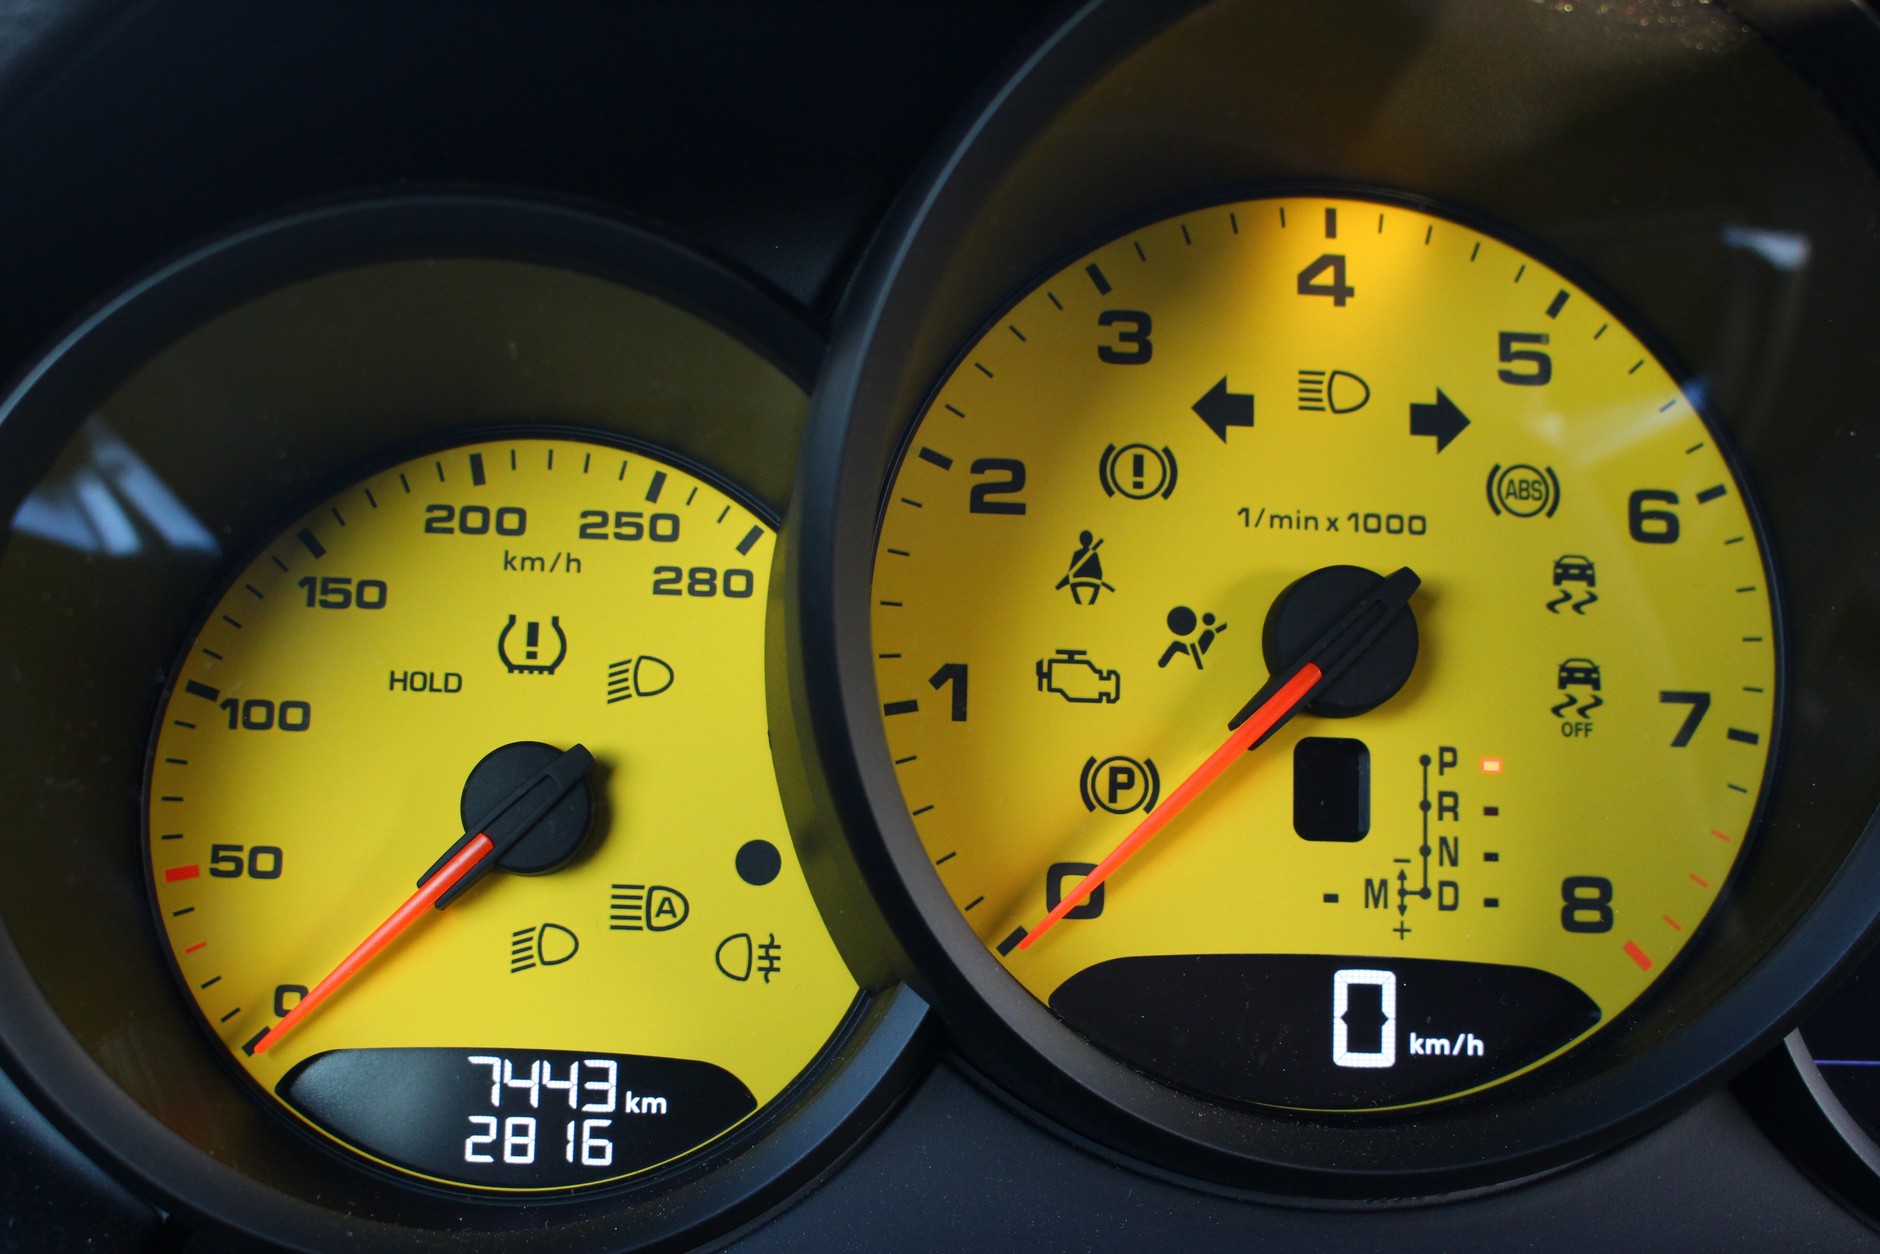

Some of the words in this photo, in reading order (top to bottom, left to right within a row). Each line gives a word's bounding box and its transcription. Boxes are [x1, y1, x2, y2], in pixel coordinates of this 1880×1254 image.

[1297, 254, 1355, 307] 4
[1098, 309, 1153, 365] 3
[1497, 331, 1553, 386] 5
[969, 457, 1027, 515] 2
[1505, 478, 1544, 502] ABS
[424, 504, 527, 536] 200
[578, 510, 680, 542] 250
[1237, 507, 1319, 531] 1/min
[1347, 512, 1427, 535] 1000
[1628, 489, 1680, 544] 6
[503, 549, 582, 574] km/h
[299, 576, 387, 610] 150
[652, 566, 754, 599] 280
[389, 670, 463, 694] HOLD
[928, 663, 968, 722] 1
[219, 697, 311, 732] 100
[1561, 721, 1594, 738] OFF
[1659, 690, 1711, 748] 7
[1438, 746, 1458, 776] P
[1108, 766, 1136, 804] P
[1438, 791, 1459, 821] R
[209, 844, 283, 880] 50
[1438, 836, 1459, 867] N
[1045, 861, 1105, 920] 0
[1364, 878, 1389, 910] M
[1438, 880, 1459, 911] D
[1560, 875, 1614, 934] 8
[655, 897, 678, 919] A
[274, 984, 309, 1018] 0
[1333, 969, 1396, 1068] 0
[1409, 1031, 1485, 1057] km/h
[467, 1055, 618, 1113] 7443
[624, 1090, 668, 1115] km
